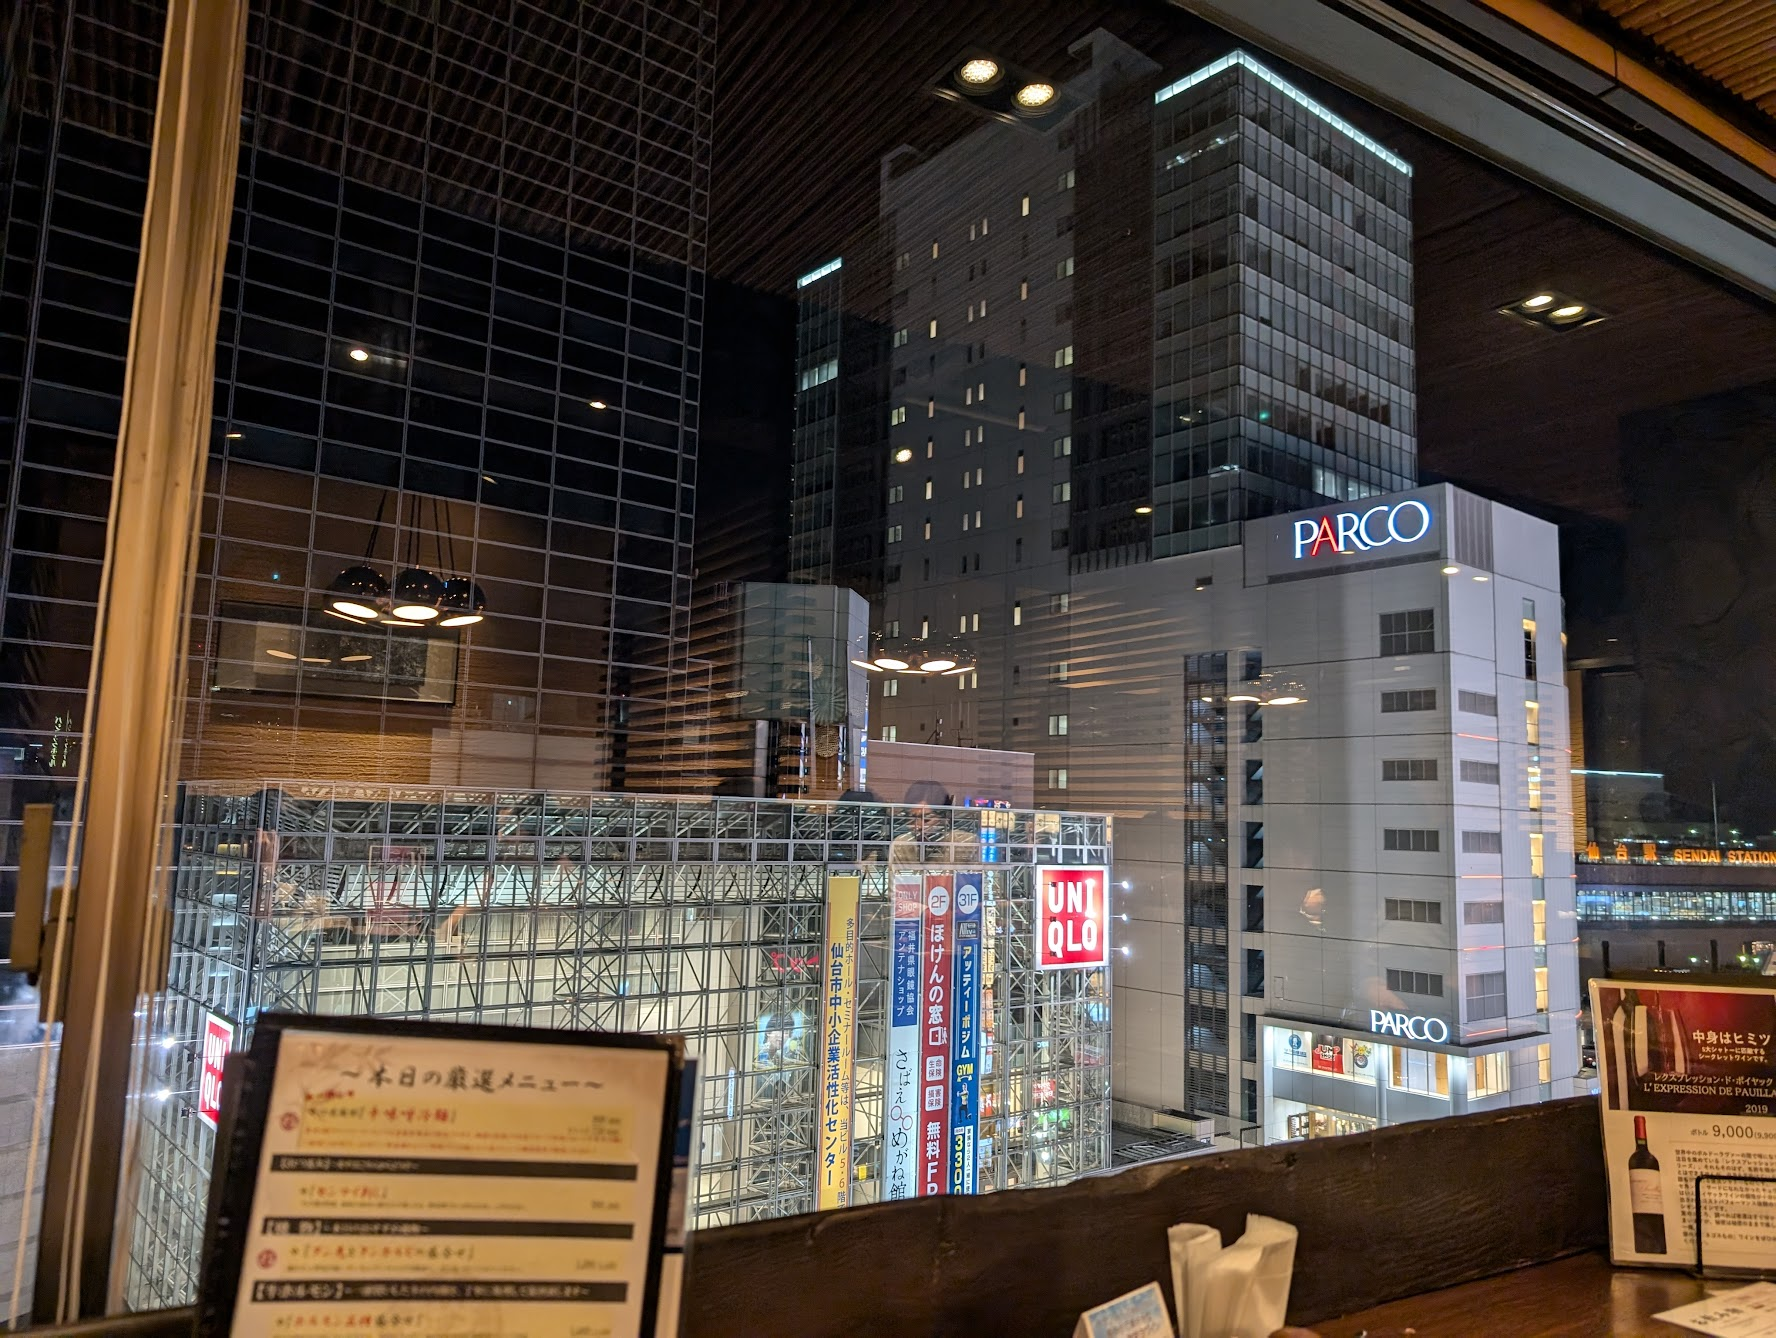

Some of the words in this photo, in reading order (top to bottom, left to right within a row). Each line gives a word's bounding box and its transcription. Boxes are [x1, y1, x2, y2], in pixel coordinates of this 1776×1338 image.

[1294, 500, 1431, 559] PARCO
[1674, 849, 1721, 863] SENDAI
[1728, 850, 1776, 864] STATION
[898, 903, 917, 912] SHOP
[931, 895, 946, 909] 2F
[958, 893, 977, 907] 31F
[1048, 879, 1097, 917] UNI
[1048, 919, 1098, 958] QLO
[896, 931, 906, 1017] アンテナショップ
[906, 930, 916, 1016] 福井県眼鏡協会
[928, 924, 945, 1046] ほけんの窓口
[960, 946, 973, 1059] アッティーボジム
[1370, 1009, 1448, 1043] PARCO
[1693, 1030, 1771, 1046] 中身はヒミツ
[825, 943, 844, 1186] 仙台市中小企業活性化センター
[895, 1049, 913, 1104] さばえ
[956, 1063, 974, 1077] GYM
[1719, 1087, 1733, 1096] DE
[1745, 1104, 1768, 1114] 2019
[1712, 1125, 1753, 1140] 9,000
